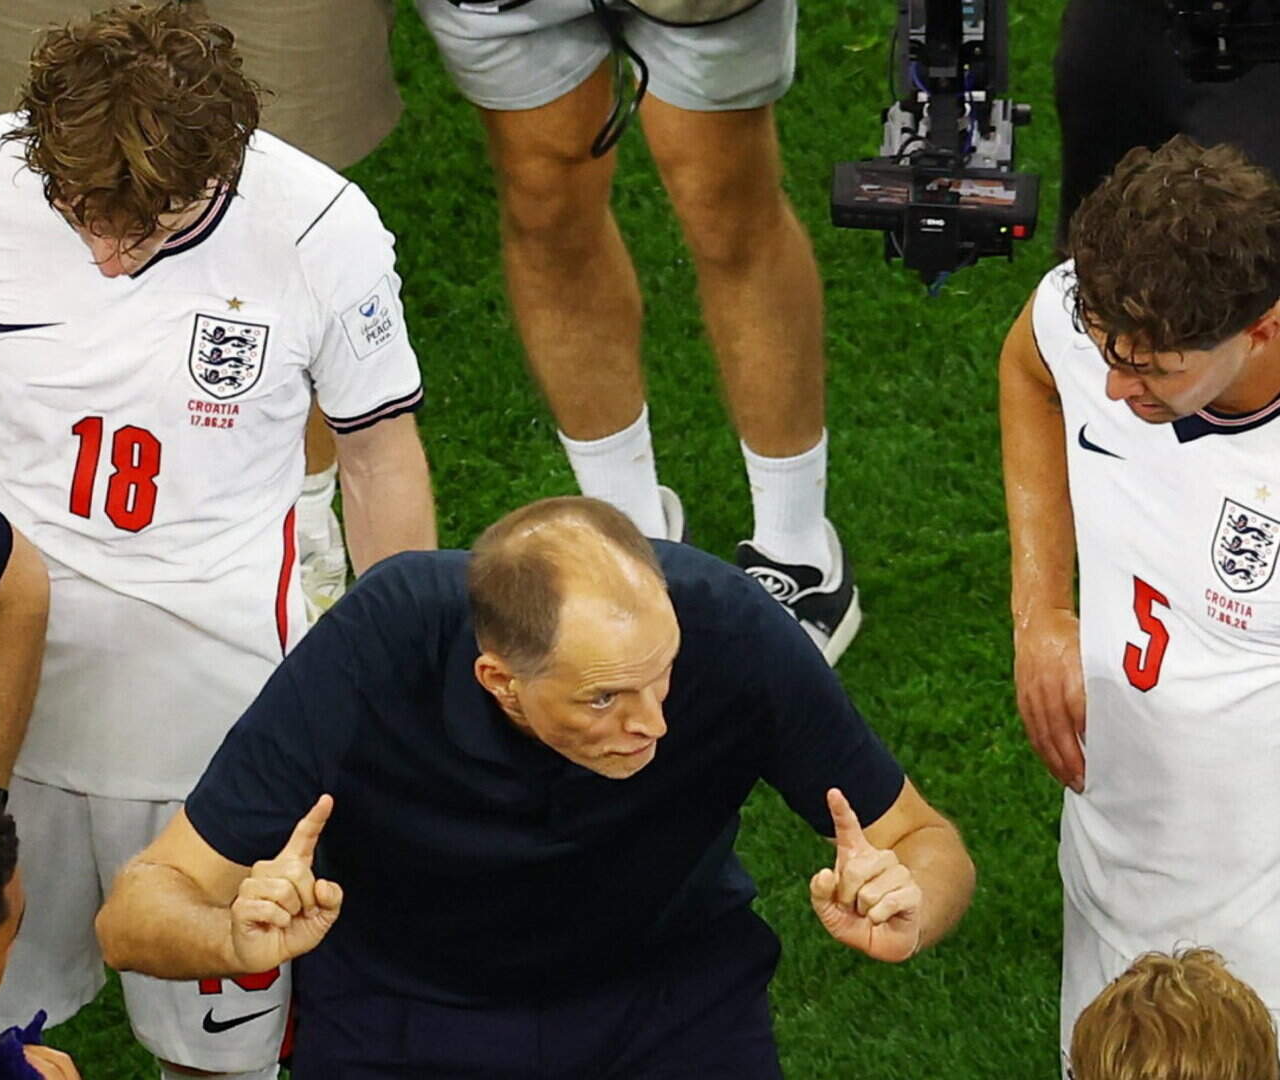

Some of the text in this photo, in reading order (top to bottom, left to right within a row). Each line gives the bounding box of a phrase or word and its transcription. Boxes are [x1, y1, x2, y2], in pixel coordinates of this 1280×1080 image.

[187, 400, 240, 415] CROATIA
[69, 416, 162, 533] 18
[1122, 574, 1171, 693] 5
[1205, 588, 1253, 617] CROATIA
